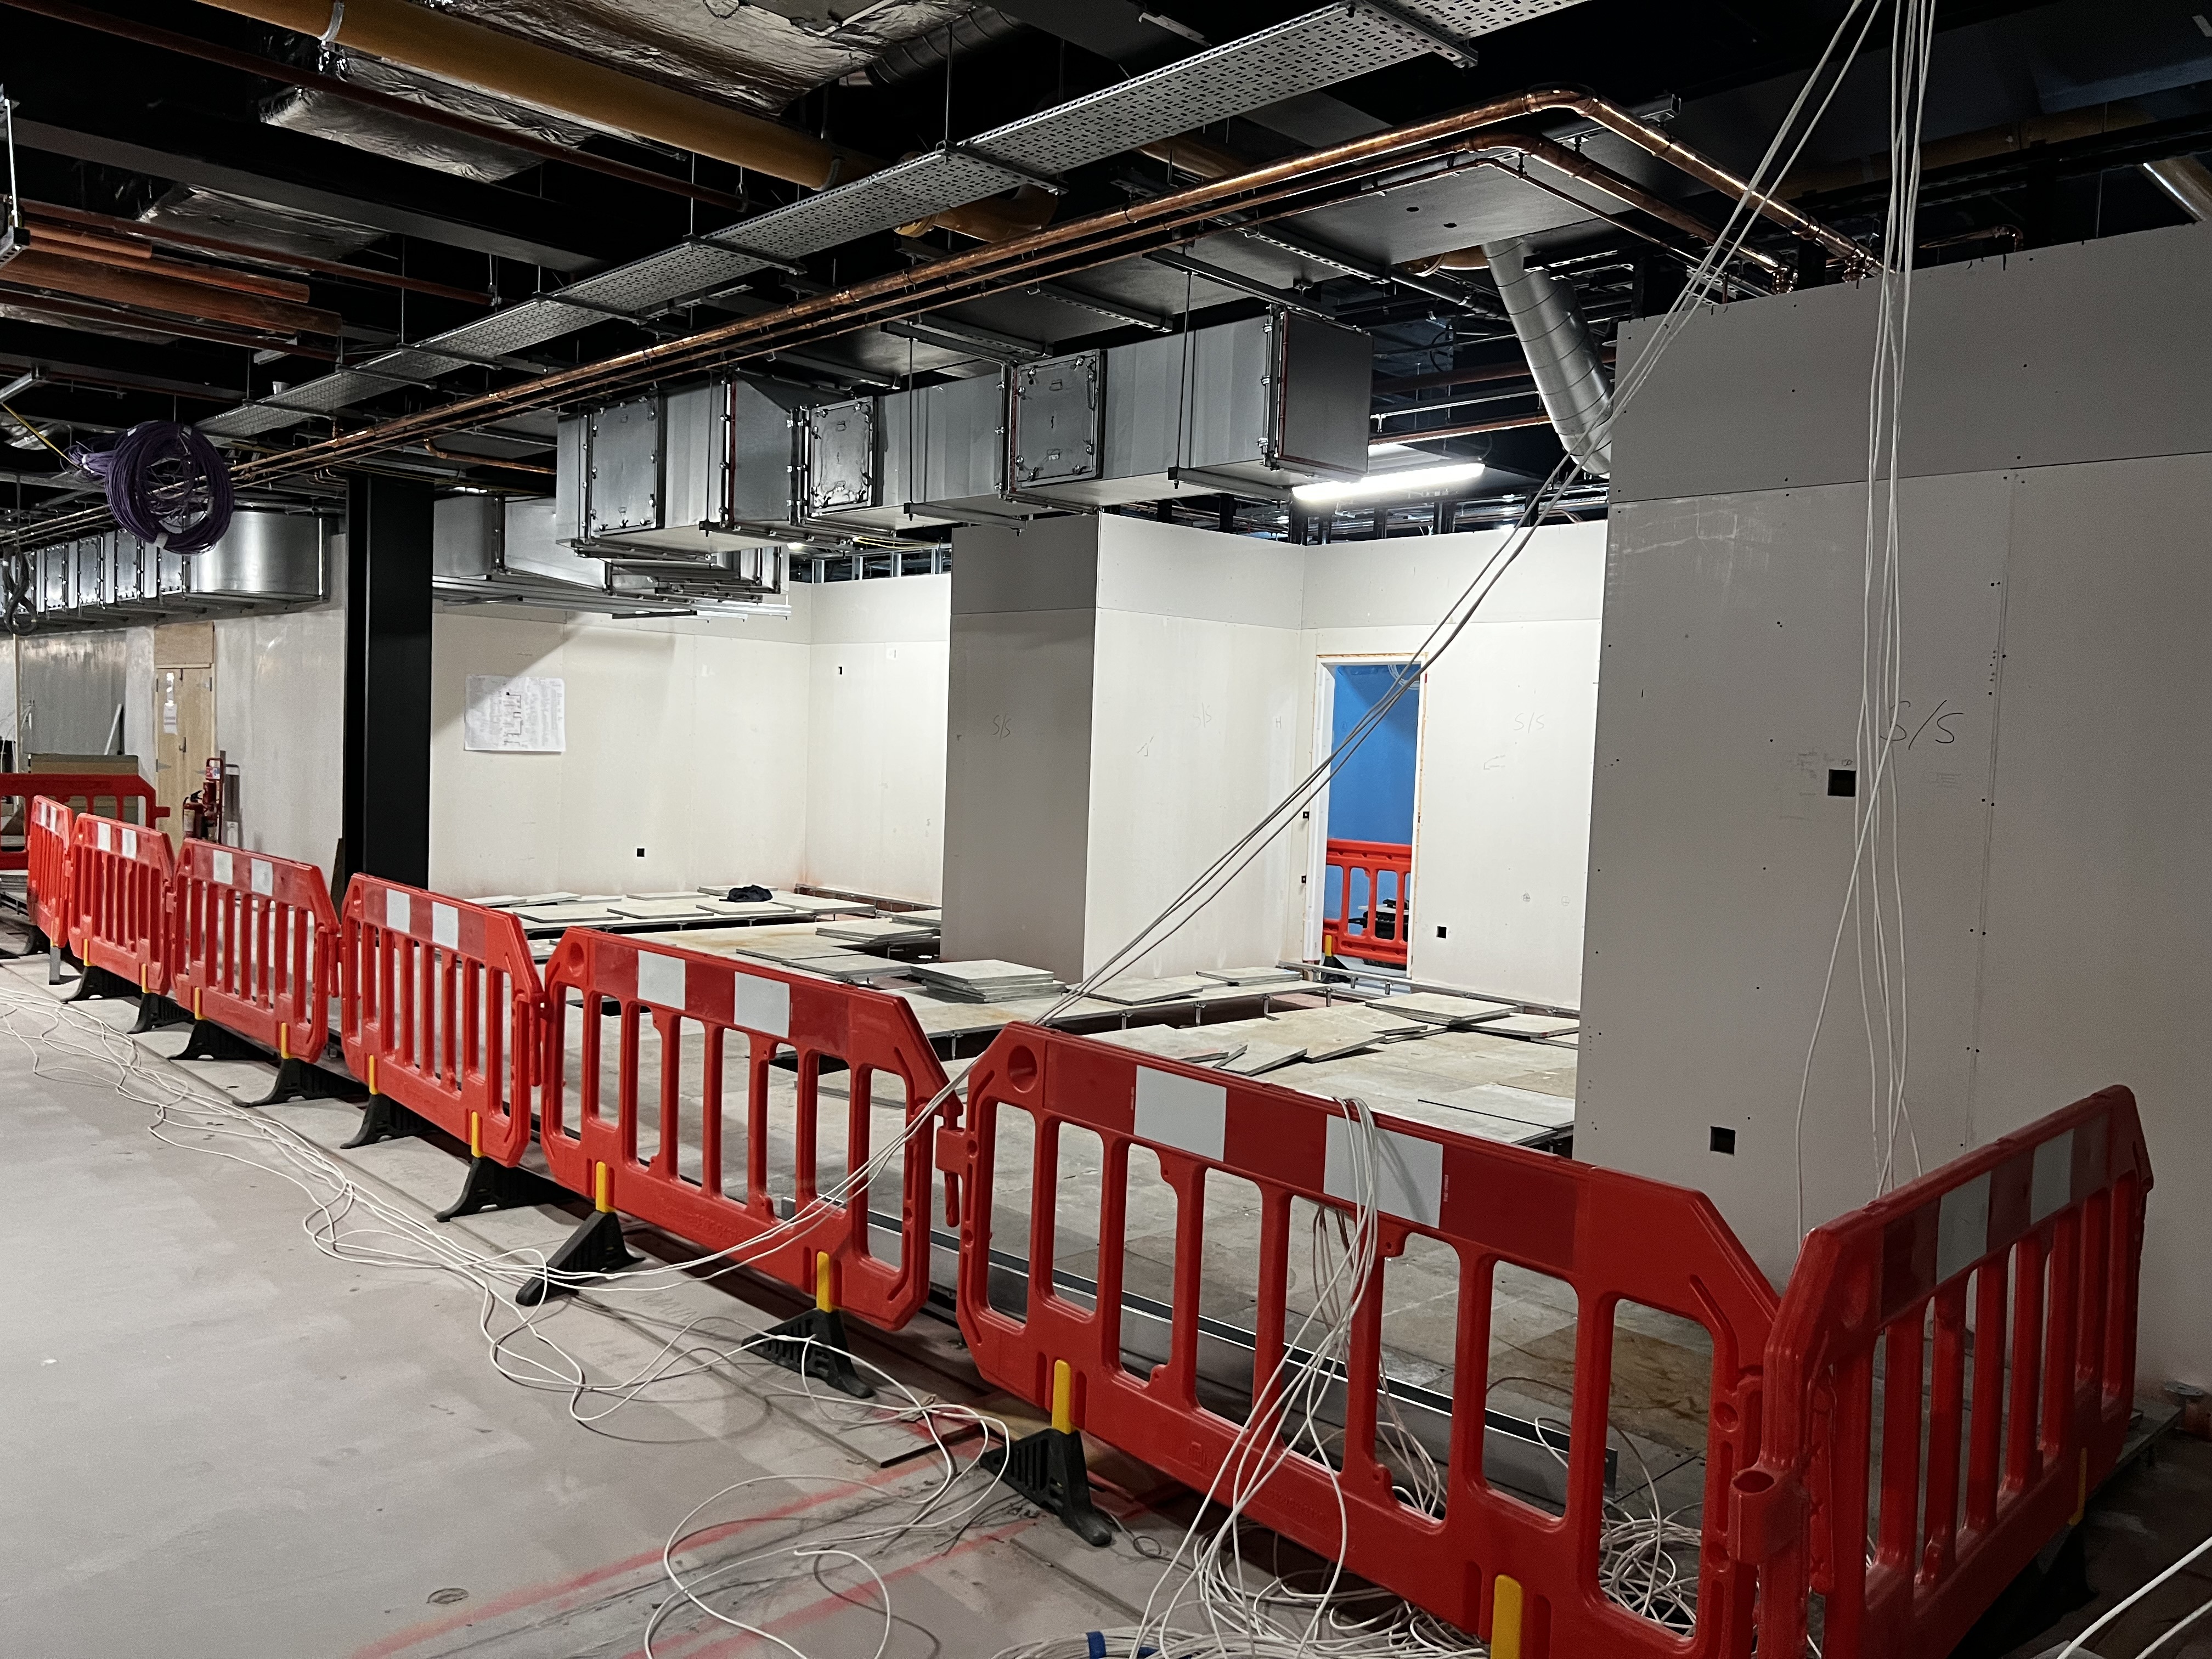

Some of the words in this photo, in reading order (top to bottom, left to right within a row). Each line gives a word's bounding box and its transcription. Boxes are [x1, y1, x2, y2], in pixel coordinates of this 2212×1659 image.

[992, 713, 1012, 740] S/S
[1513, 711, 1545, 734] S/S
[1879, 699, 1964, 751] S/S
